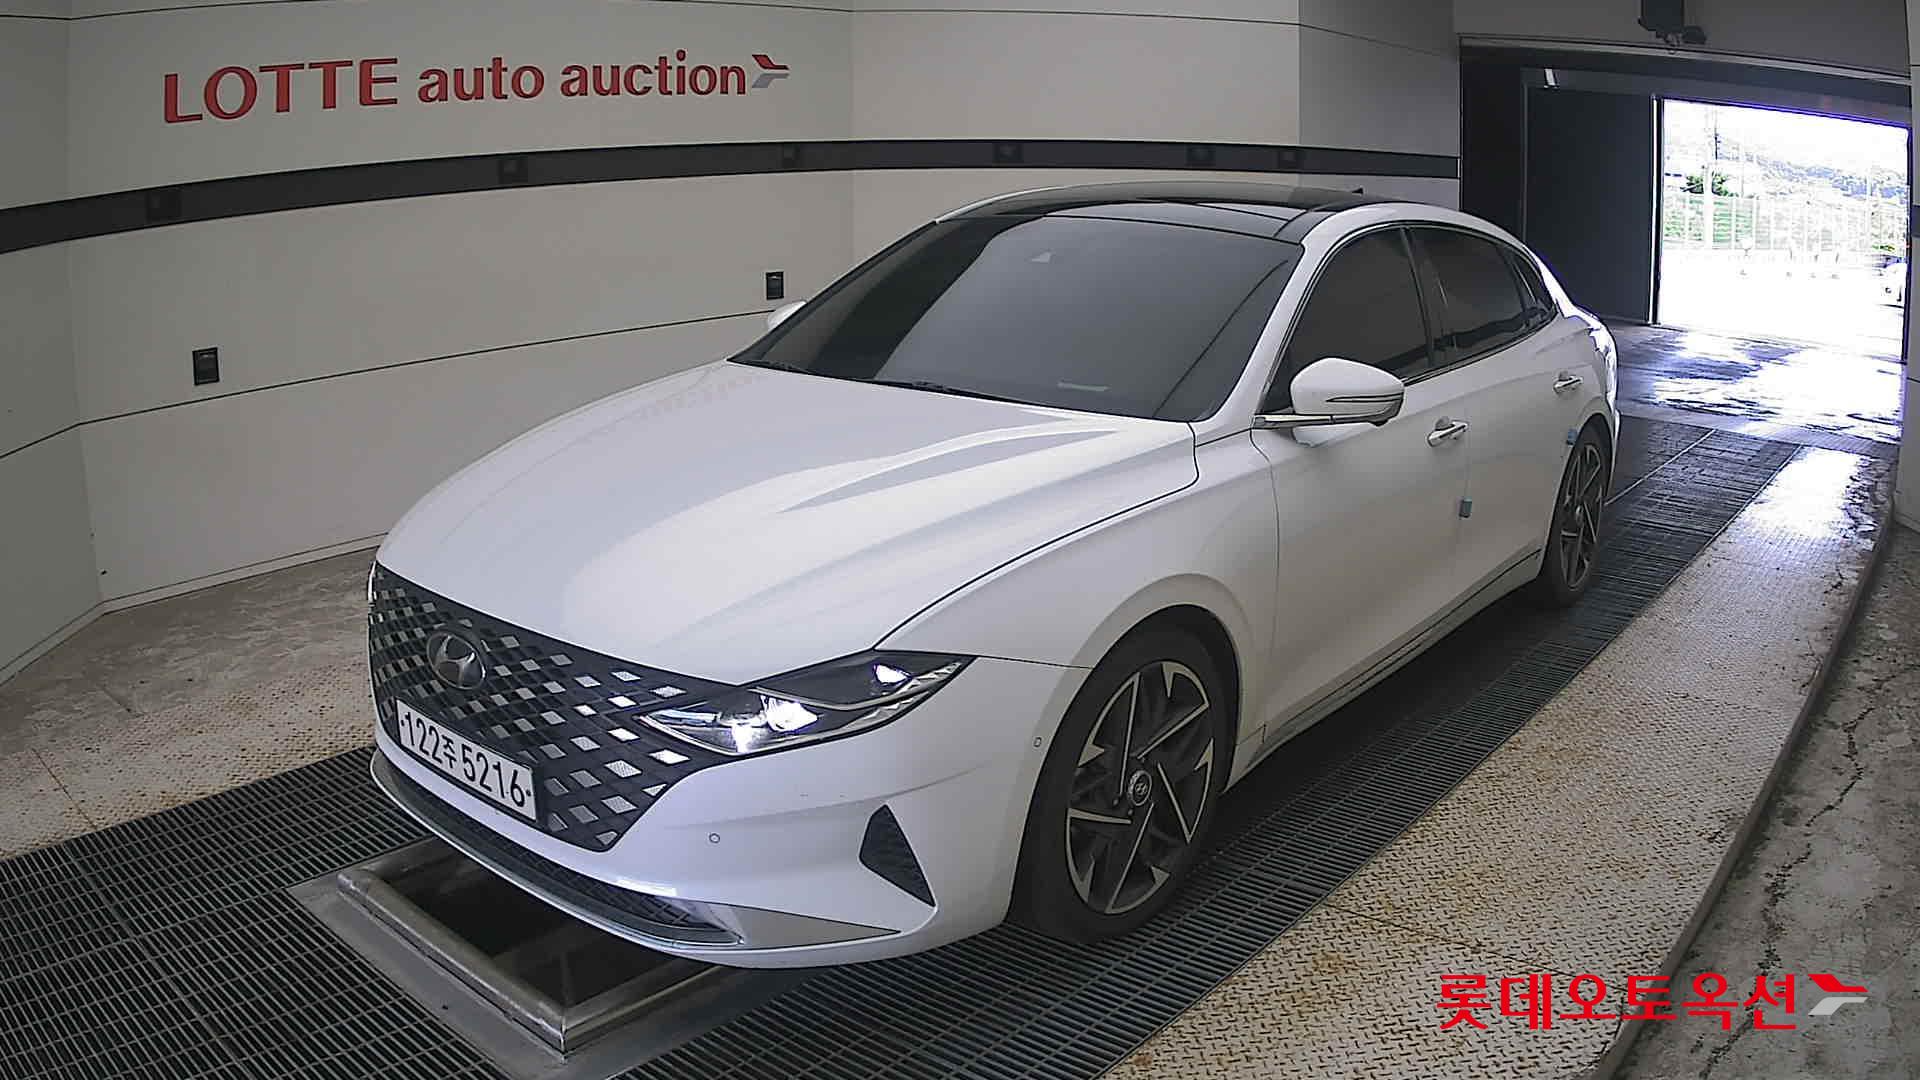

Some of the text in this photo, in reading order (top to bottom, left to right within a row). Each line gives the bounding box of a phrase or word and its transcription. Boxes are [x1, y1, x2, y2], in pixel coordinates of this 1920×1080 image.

[164, 49, 746, 123] LOTTE auto auction
